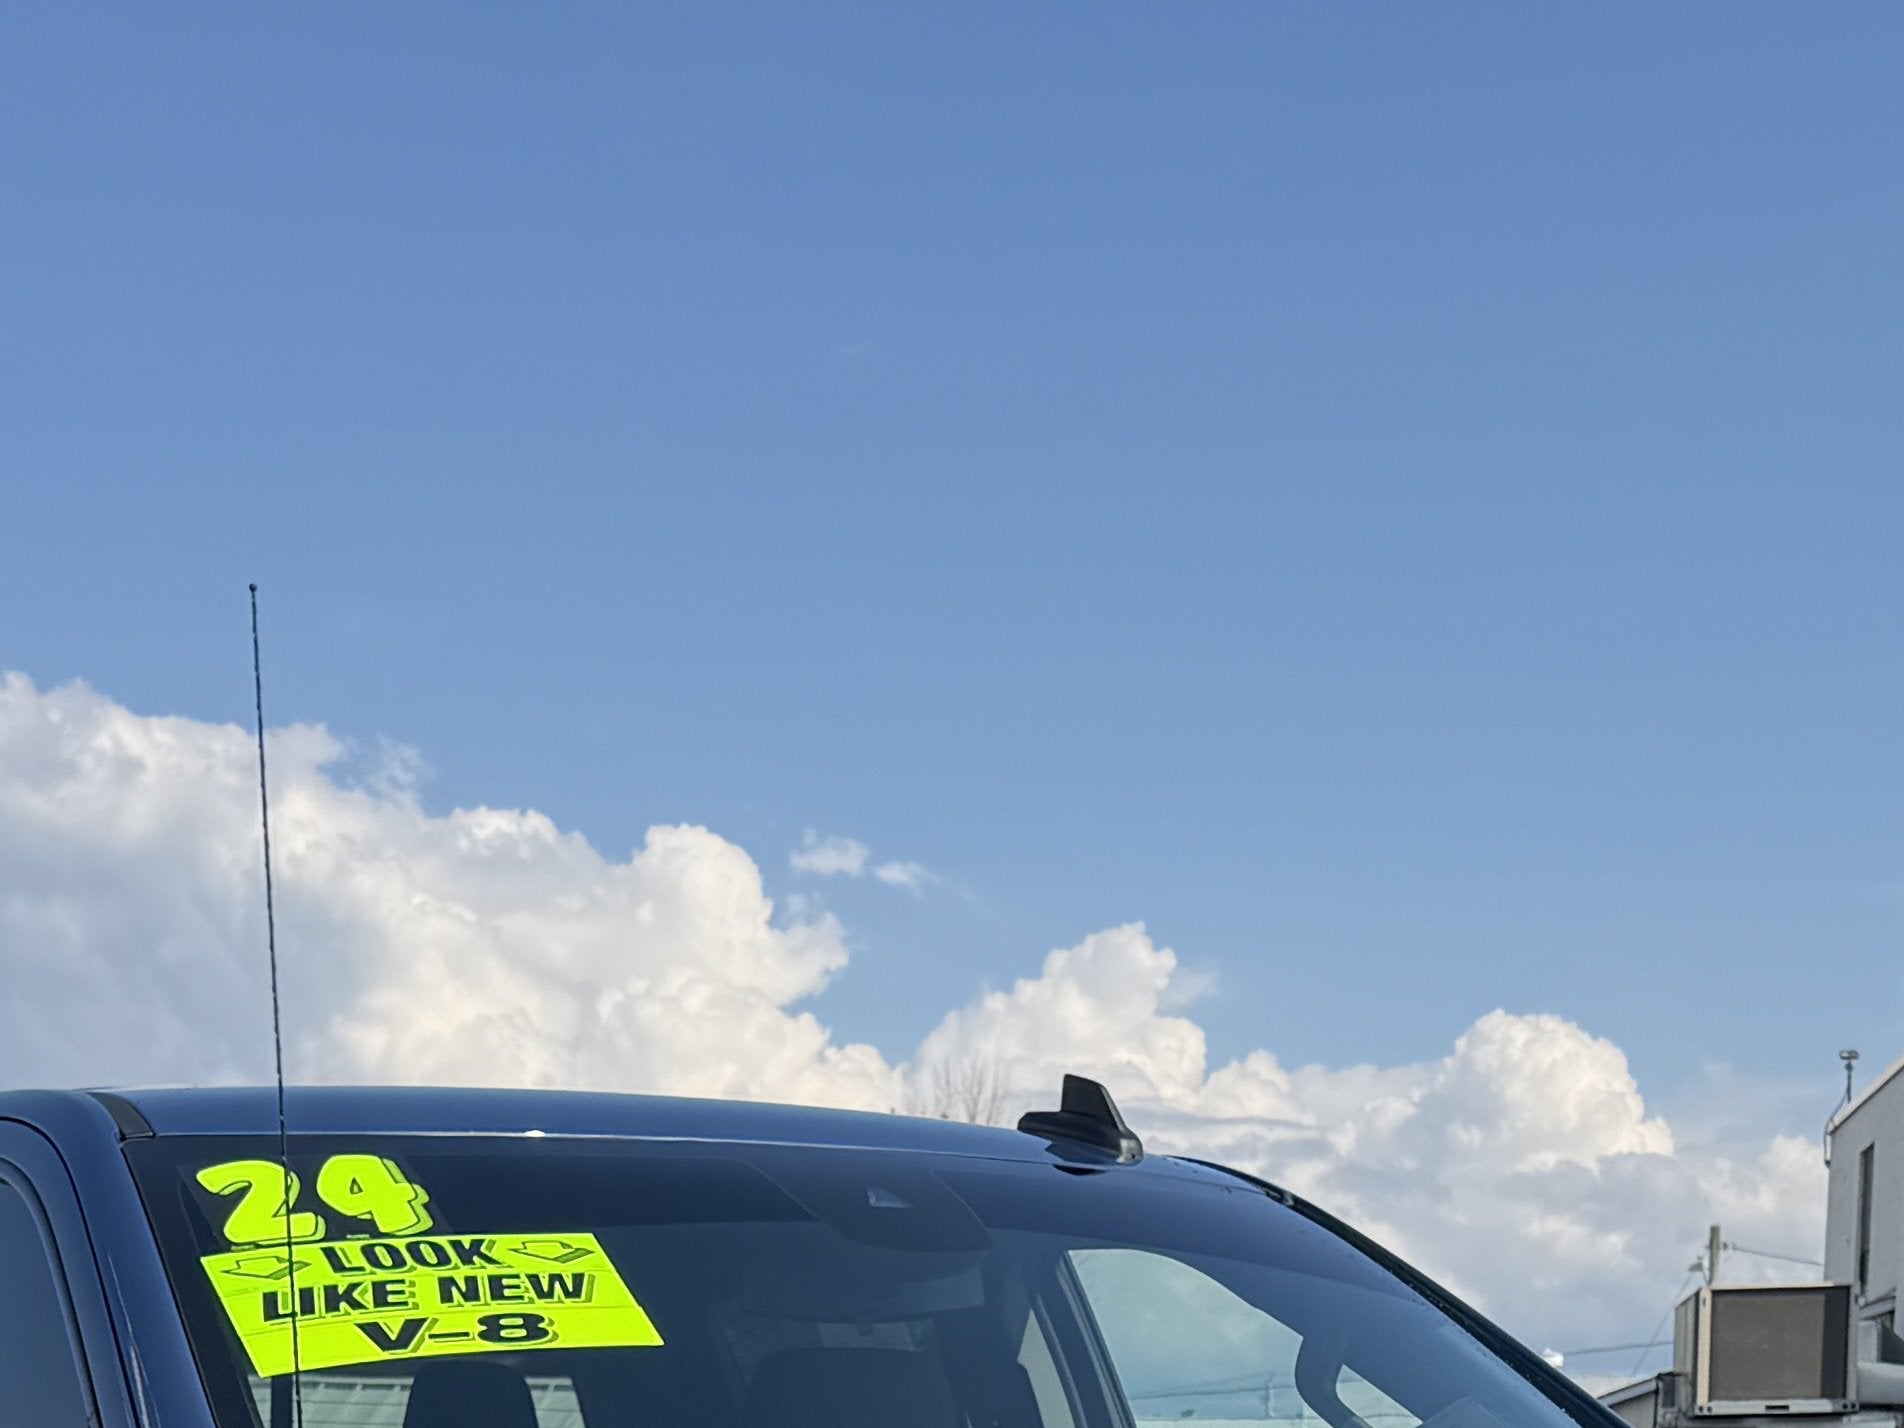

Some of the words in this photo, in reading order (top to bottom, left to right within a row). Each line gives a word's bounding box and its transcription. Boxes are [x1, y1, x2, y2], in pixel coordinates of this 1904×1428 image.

[196, 1154, 434, 1245] 24
[324, 1238, 505, 1276] LOOK
[260, 1278, 419, 1323] LIKE
[438, 1272, 596, 1308] NEW
[357, 1313, 559, 1354] V-8
